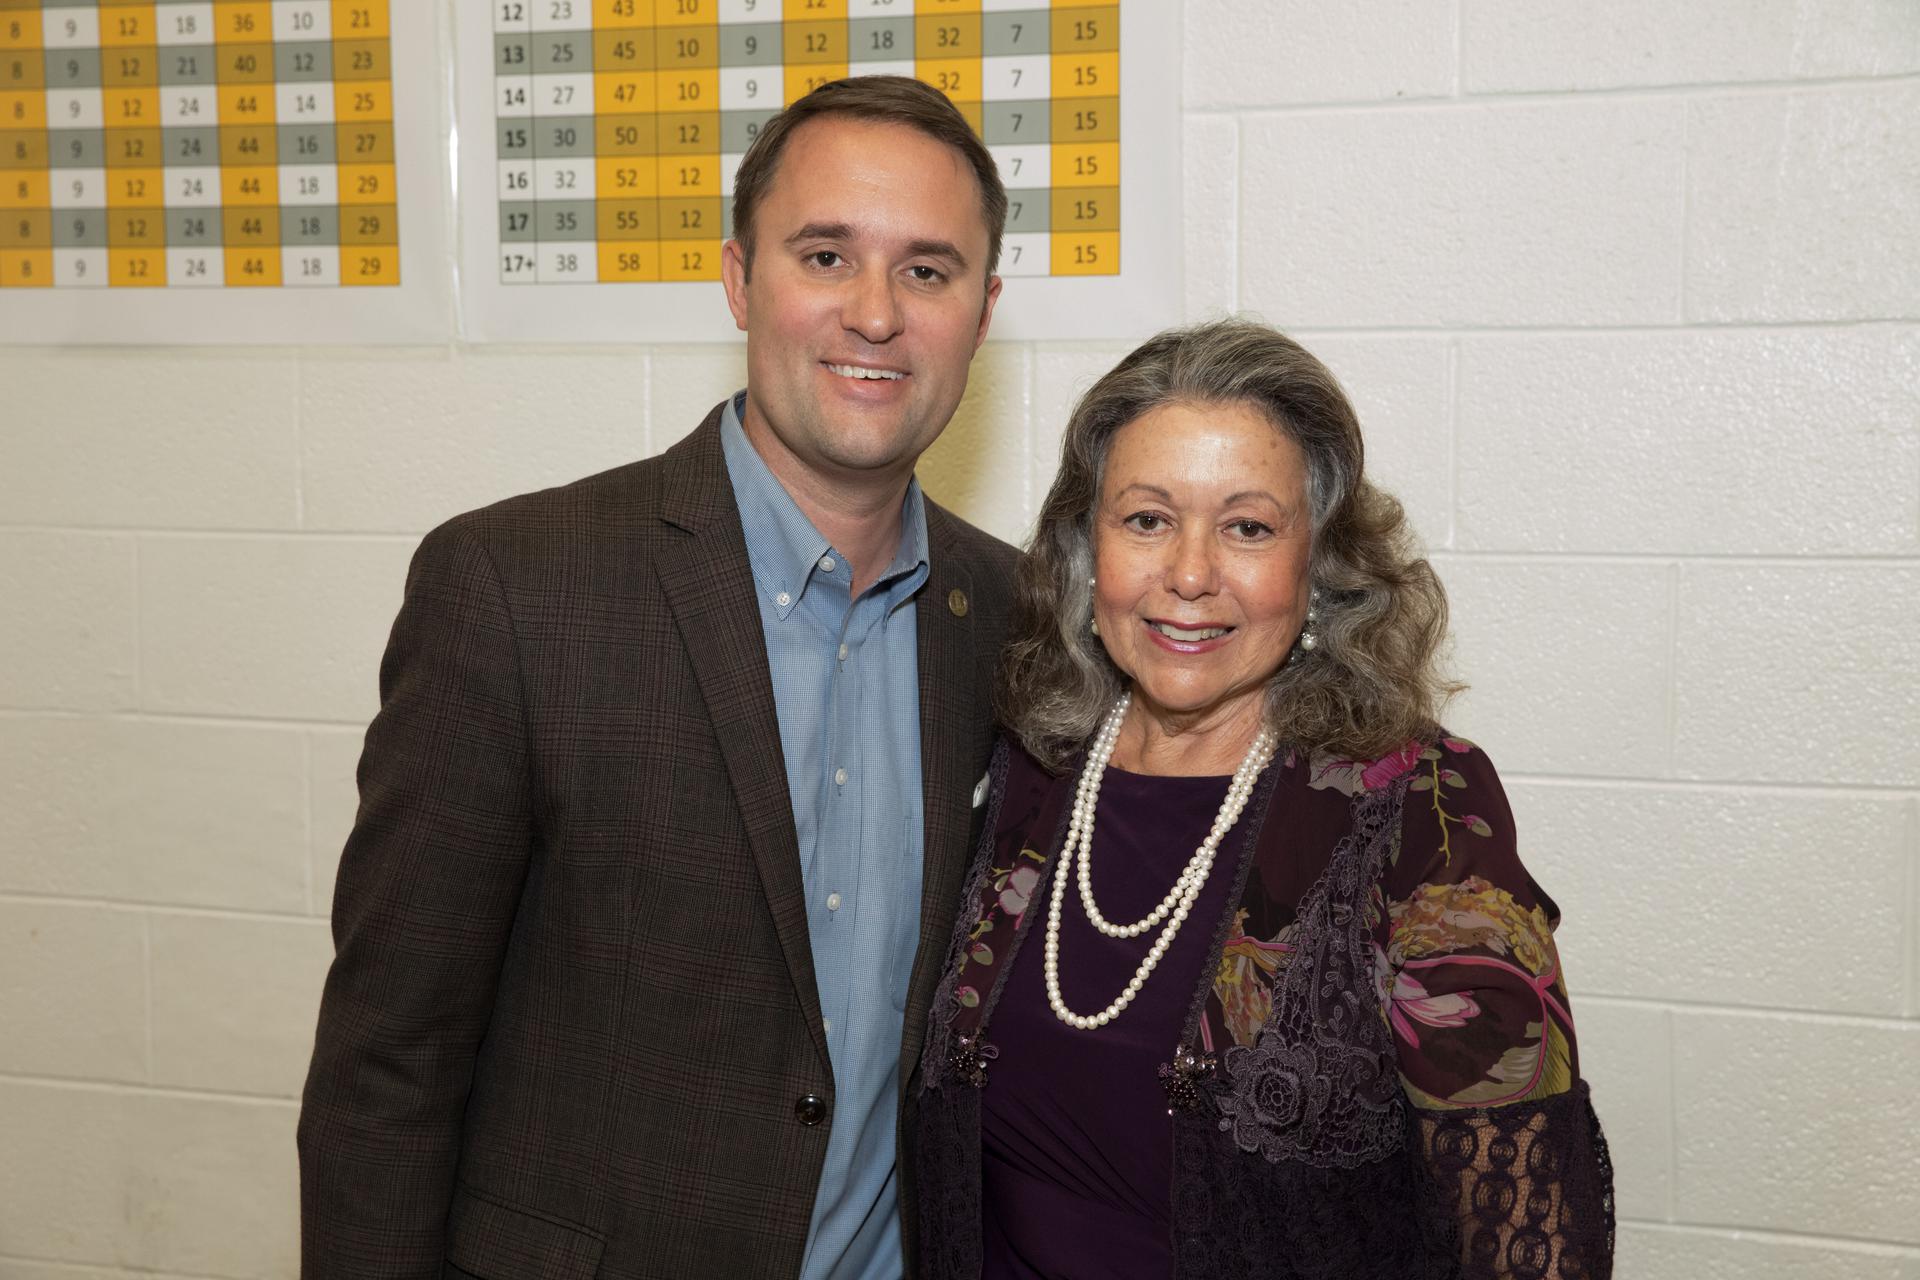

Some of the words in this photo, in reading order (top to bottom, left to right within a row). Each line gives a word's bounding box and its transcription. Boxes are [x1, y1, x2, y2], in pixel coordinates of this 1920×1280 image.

[10, 21, 20, 39] 8
[66, 19, 77, 37] 9
[120, 17, 138, 36] 12
[176, 15, 196, 34] 18
[234, 14, 254, 32] 36
[293, 12, 313, 30] 10
[351, 9, 370, 28] 21
[503, 4, 522, 21] 12
[551, 1, 572, 20] 23
[612, 0, 634, 16] 43
[678, 0, 698, 15] 10
[504, 46, 524, 64] 13
[552, 43, 573, 62] 25
[613, 41, 635, 59] 45
[678, 38, 699, 58] 10
[745, 36, 757, 55] 9
[806, 33, 827, 52] 12
[872, 30, 894, 50] 18
[938, 27, 960, 47] 32
[1011, 24, 1022, 43] 7
[1075, 21, 1097, 40] 15
[12, 61, 22, 79] 8
[67, 60, 79, 78] 9
[121, 58, 139, 77] 12
[177, 56, 197, 75] 21
[234, 55, 256, 73] 40
[294, 53, 314, 72] 12
[352, 51, 373, 70] 23
[506, 88, 525, 105] 14
[553, 86, 574, 105] 27
[614, 84, 636, 101] 47
[678, 82, 700, 101] 10
[746, 80, 757, 98] 9
[938, 72, 960, 91] 32
[1012, 69, 1022, 87] 7
[1076, 66, 1097, 85] 15
[14, 102, 24, 119] 8
[69, 100, 80, 118] 9
[123, 99, 141, 117] 12
[180, 98, 199, 116] 24
[237, 95, 257, 113] 44
[297, 95, 315, 113] 14
[355, 93, 374, 111] 25
[506, 130, 526, 148] 15
[555, 128, 576, 147] 30
[616, 126, 638, 145] 50
[679, 125, 699, 143] 12
[747, 123, 758, 141] 9
[1012, 114, 1022, 132] 7
[1075, 111, 1097, 130] 15
[16, 141, 27, 160] 8
[71, 140, 82, 158] 9
[125, 139, 143, 158] 12
[182, 139, 201, 156] 24
[238, 137, 258, 154] 44
[298, 135, 318, 154] 16
[356, 134, 376, 153] 27
[508, 172, 528, 189] 16
[556, 170, 576, 189] 32
[616, 169, 637, 187] 52
[680, 167, 700, 186] 12
[1012, 158, 1022, 176] 7
[1076, 156, 1098, 175] 15
[18, 181, 28, 198] 8
[72, 180, 83, 198] 9
[126, 179, 145, 198] 12
[184, 179, 203, 196] 24
[240, 177, 260, 195] 44
[300, 177, 319, 195] 18
[358, 175, 378, 194] 29
[20, 220, 30, 237] 8
[74, 219, 85, 237] 9
[127, 219, 146, 237] 12
[185, 219, 204, 236] 24
[241, 218, 262, 235] 44
[301, 217, 321, 235] 18
[359, 216, 380, 235] 29
[509, 213, 528, 231] 17
[556, 212, 577, 230] 35
[617, 211, 639, 229] 55
[681, 210, 701, 228] 12
[1011, 202, 1022, 220] 7
[1075, 201, 1097, 219] 15
[22, 260, 32, 277] 8
[75, 259, 86, 277] 9
[129, 259, 147, 277] 12
[186, 259, 206, 277] 24
[243, 258, 264, 275] 44
[302, 258, 322, 276] 18
[360, 257, 381, 275] 29
[505, 255, 535, 272] 17+
[557, 254, 578, 272] 38
[618, 253, 640, 271] 58
[682, 252, 701, 270] 12
[1012, 246, 1022, 264] 7
[1075, 245, 1097, 264] 15
